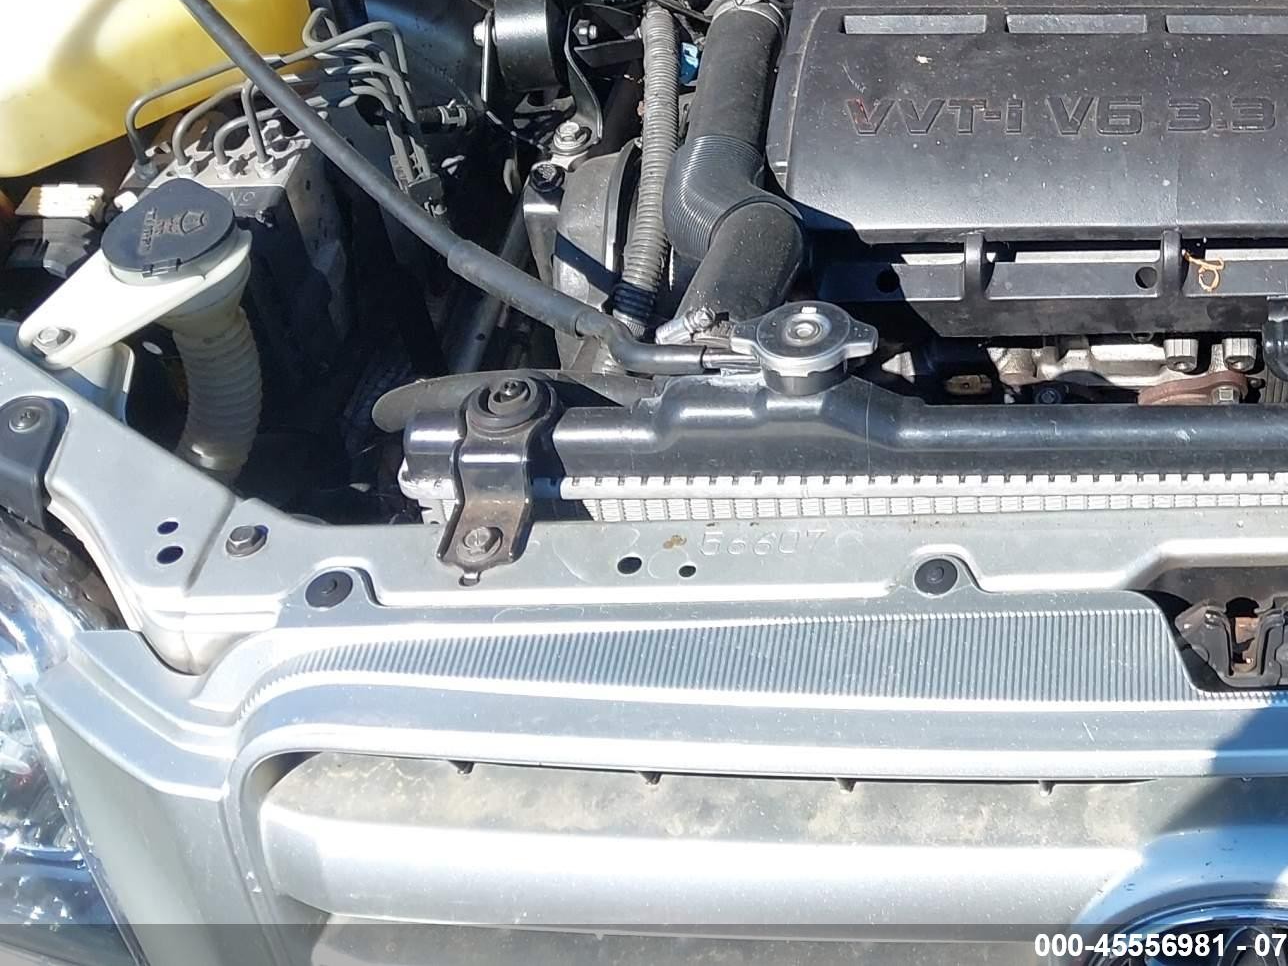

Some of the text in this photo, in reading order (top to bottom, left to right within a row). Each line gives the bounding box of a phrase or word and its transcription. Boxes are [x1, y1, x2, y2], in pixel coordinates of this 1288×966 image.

[846, 96, 1276, 136] VVT-i V6 3.3
